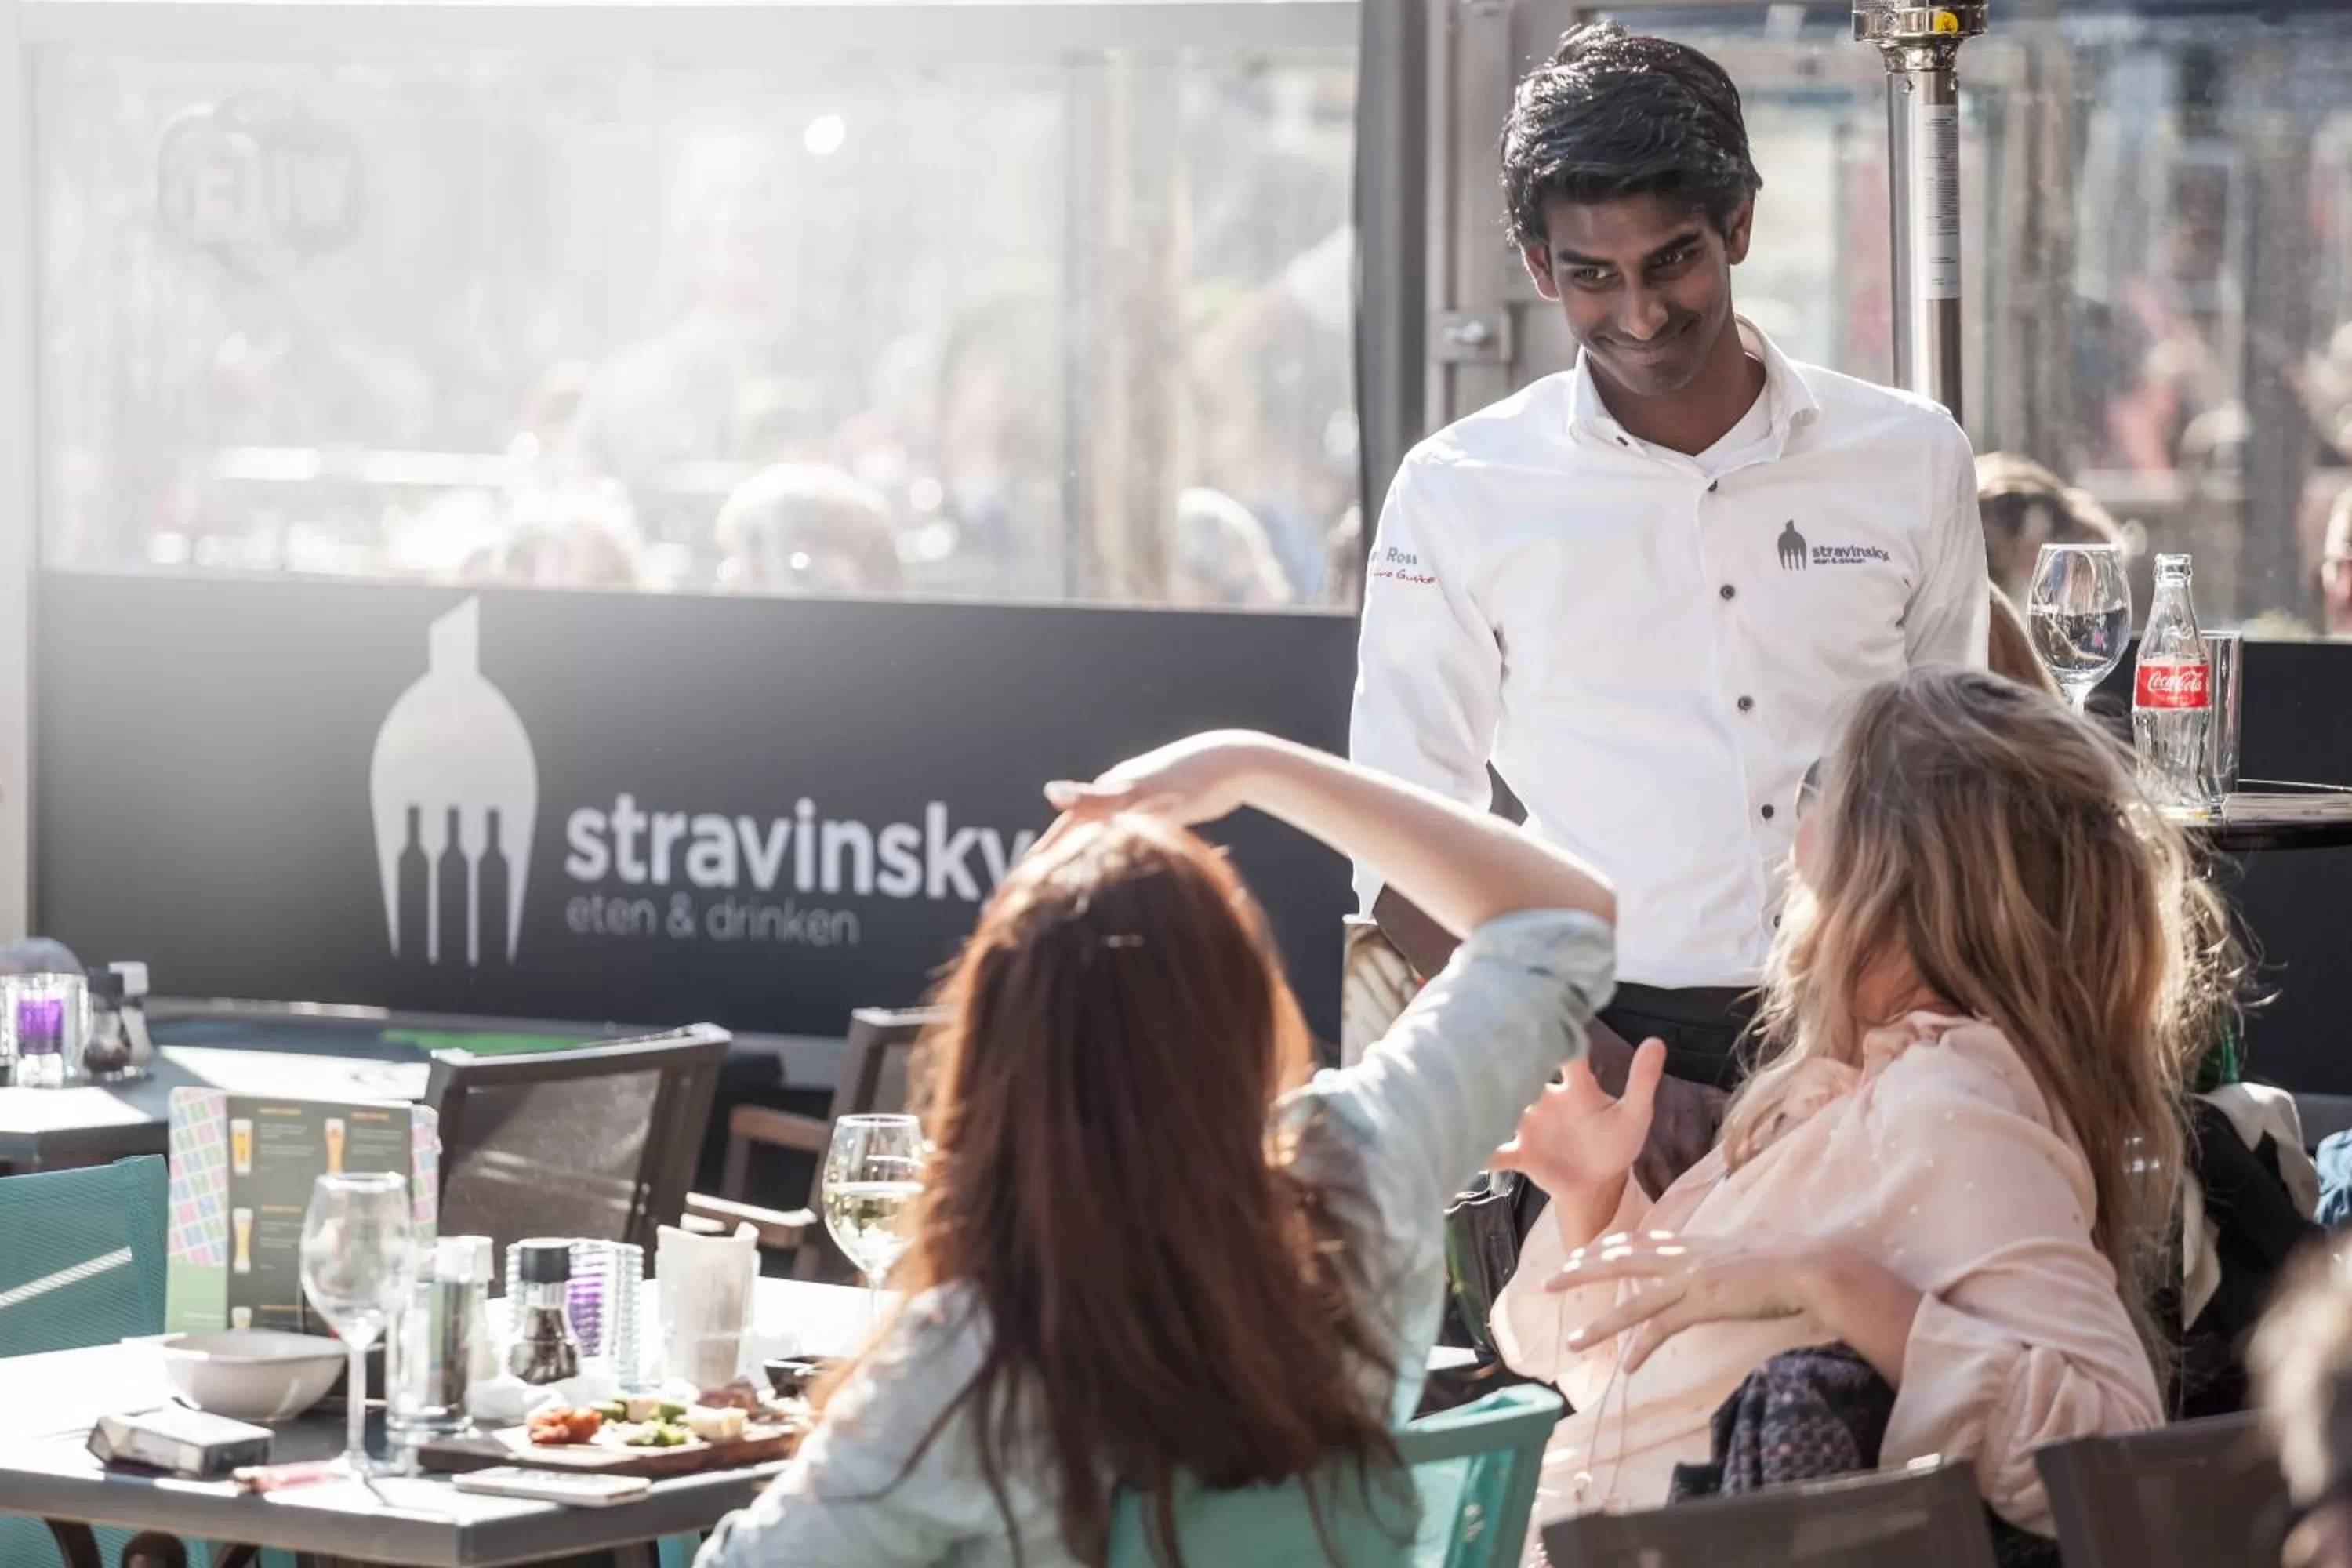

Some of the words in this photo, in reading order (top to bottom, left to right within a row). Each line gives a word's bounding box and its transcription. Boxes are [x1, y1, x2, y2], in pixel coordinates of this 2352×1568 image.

[1812, 544, 1891, 561] stravinsky
[565, 891, 658, 936] eten
[666, 890, 696, 939] &
[706, 895, 861, 947] drinken
